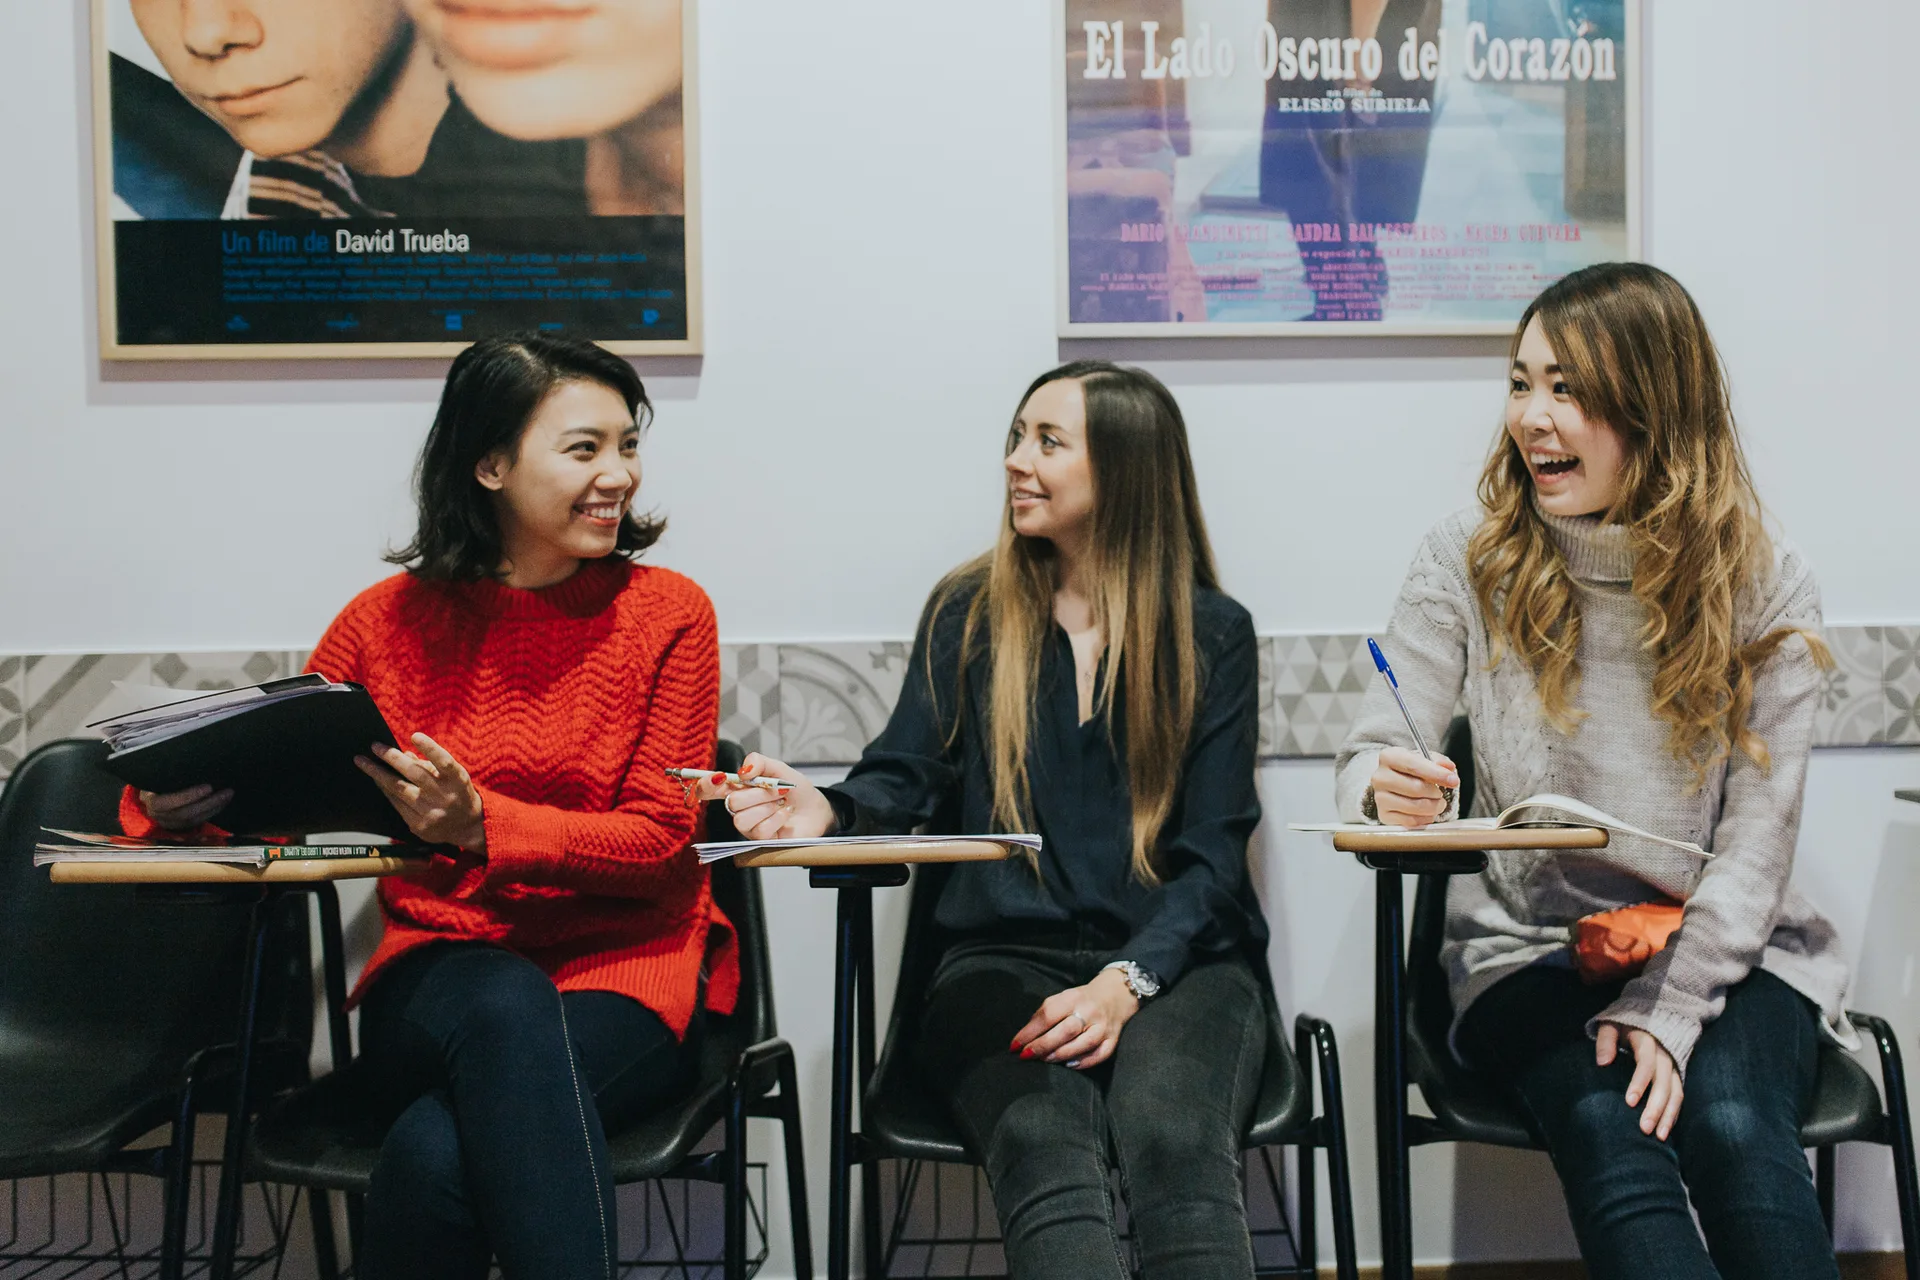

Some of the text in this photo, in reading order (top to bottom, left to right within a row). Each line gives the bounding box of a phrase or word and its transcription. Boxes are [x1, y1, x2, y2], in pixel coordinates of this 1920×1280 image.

[1083, 19, 1616, 81] El Lado Oscuro del Corazón
[1278, 98, 1431, 113] ELISEO SUBIELA
[222, 229, 469, 253] Un film de David Trueba
[1120, 223, 1164, 242] DARIO
[1286, 223, 1341, 242] SANDRA
